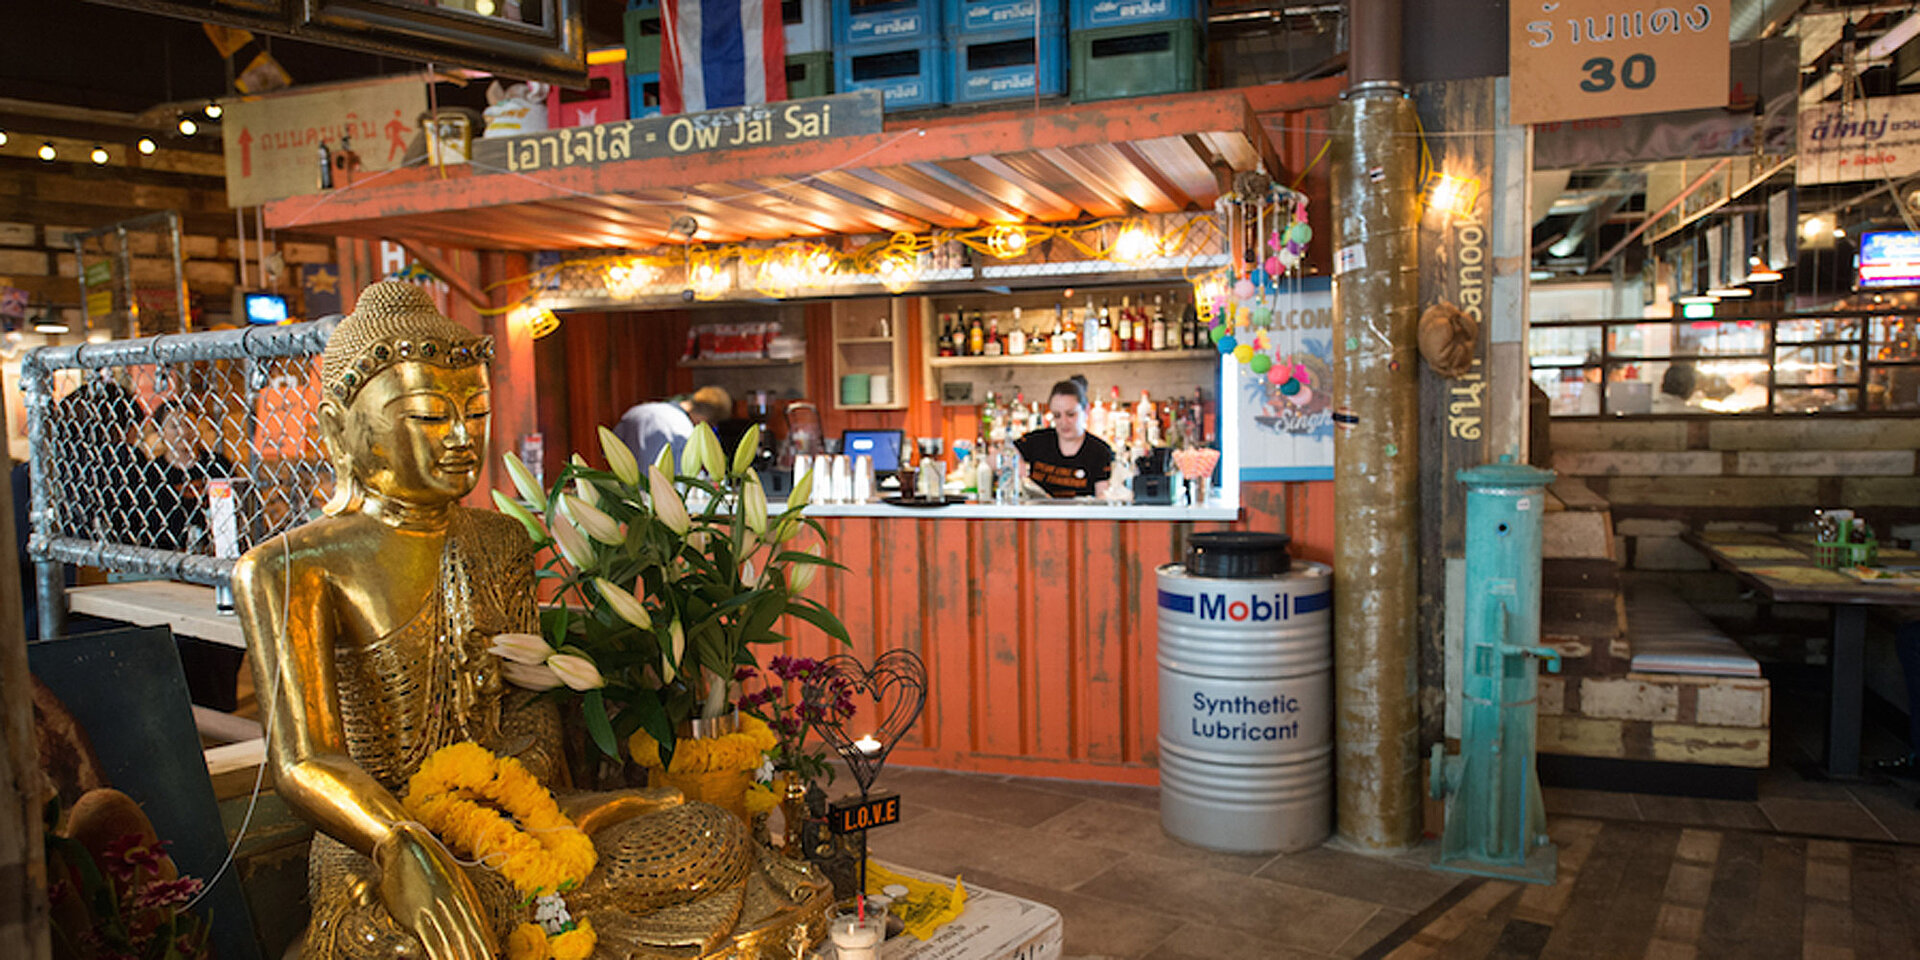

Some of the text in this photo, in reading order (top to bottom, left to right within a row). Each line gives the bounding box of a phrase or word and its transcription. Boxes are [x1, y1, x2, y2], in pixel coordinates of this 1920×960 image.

[1580, 53, 1656, 93] 30
[668, 118, 720, 152] Ow
[729, 111, 772, 145] Jai
[784, 104, 831, 139] Sai
[1200, 592, 1288, 621] Mobil
[1193, 691, 1299, 716] Synthetic
[1192, 717, 1298, 741] Lubricant
[844, 799, 896, 832] L.O.V.E
